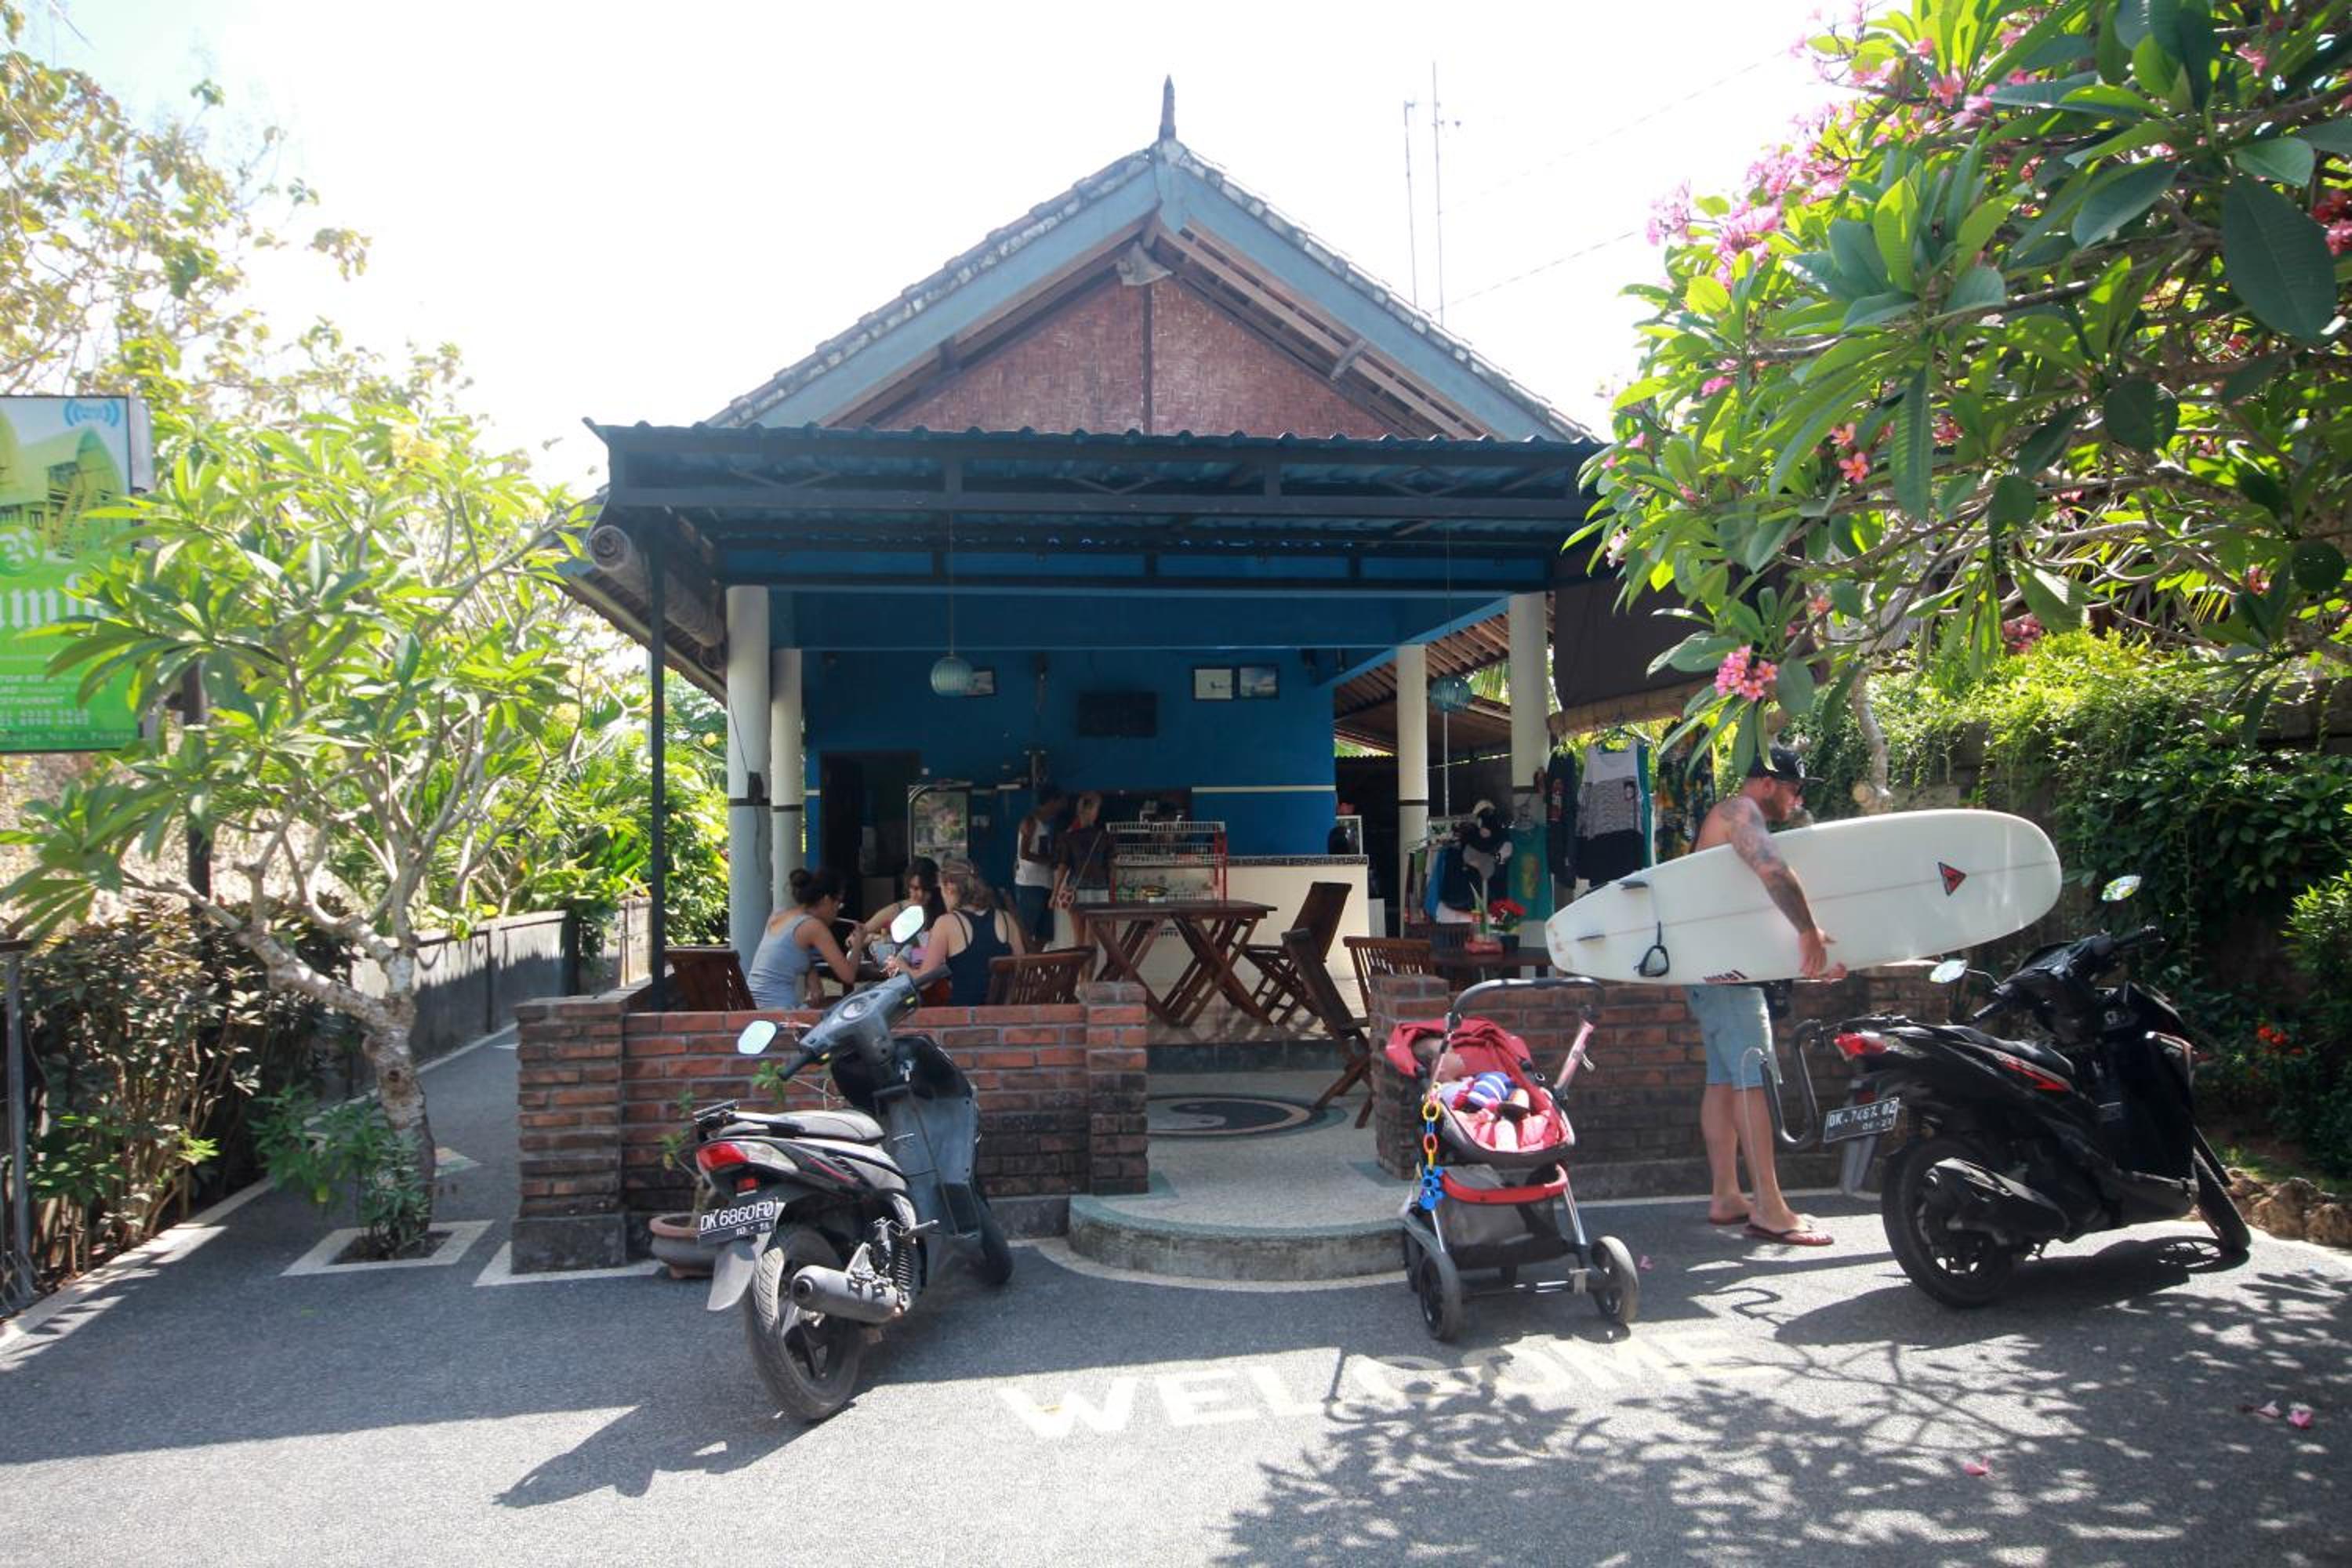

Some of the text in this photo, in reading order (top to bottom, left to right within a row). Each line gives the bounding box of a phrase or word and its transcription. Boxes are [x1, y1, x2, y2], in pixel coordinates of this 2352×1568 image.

[701, 1209, 719, 1231] DK
[720, 1205, 755, 1226] 6860
[994, 1328, 1788, 1439] WELCOME
